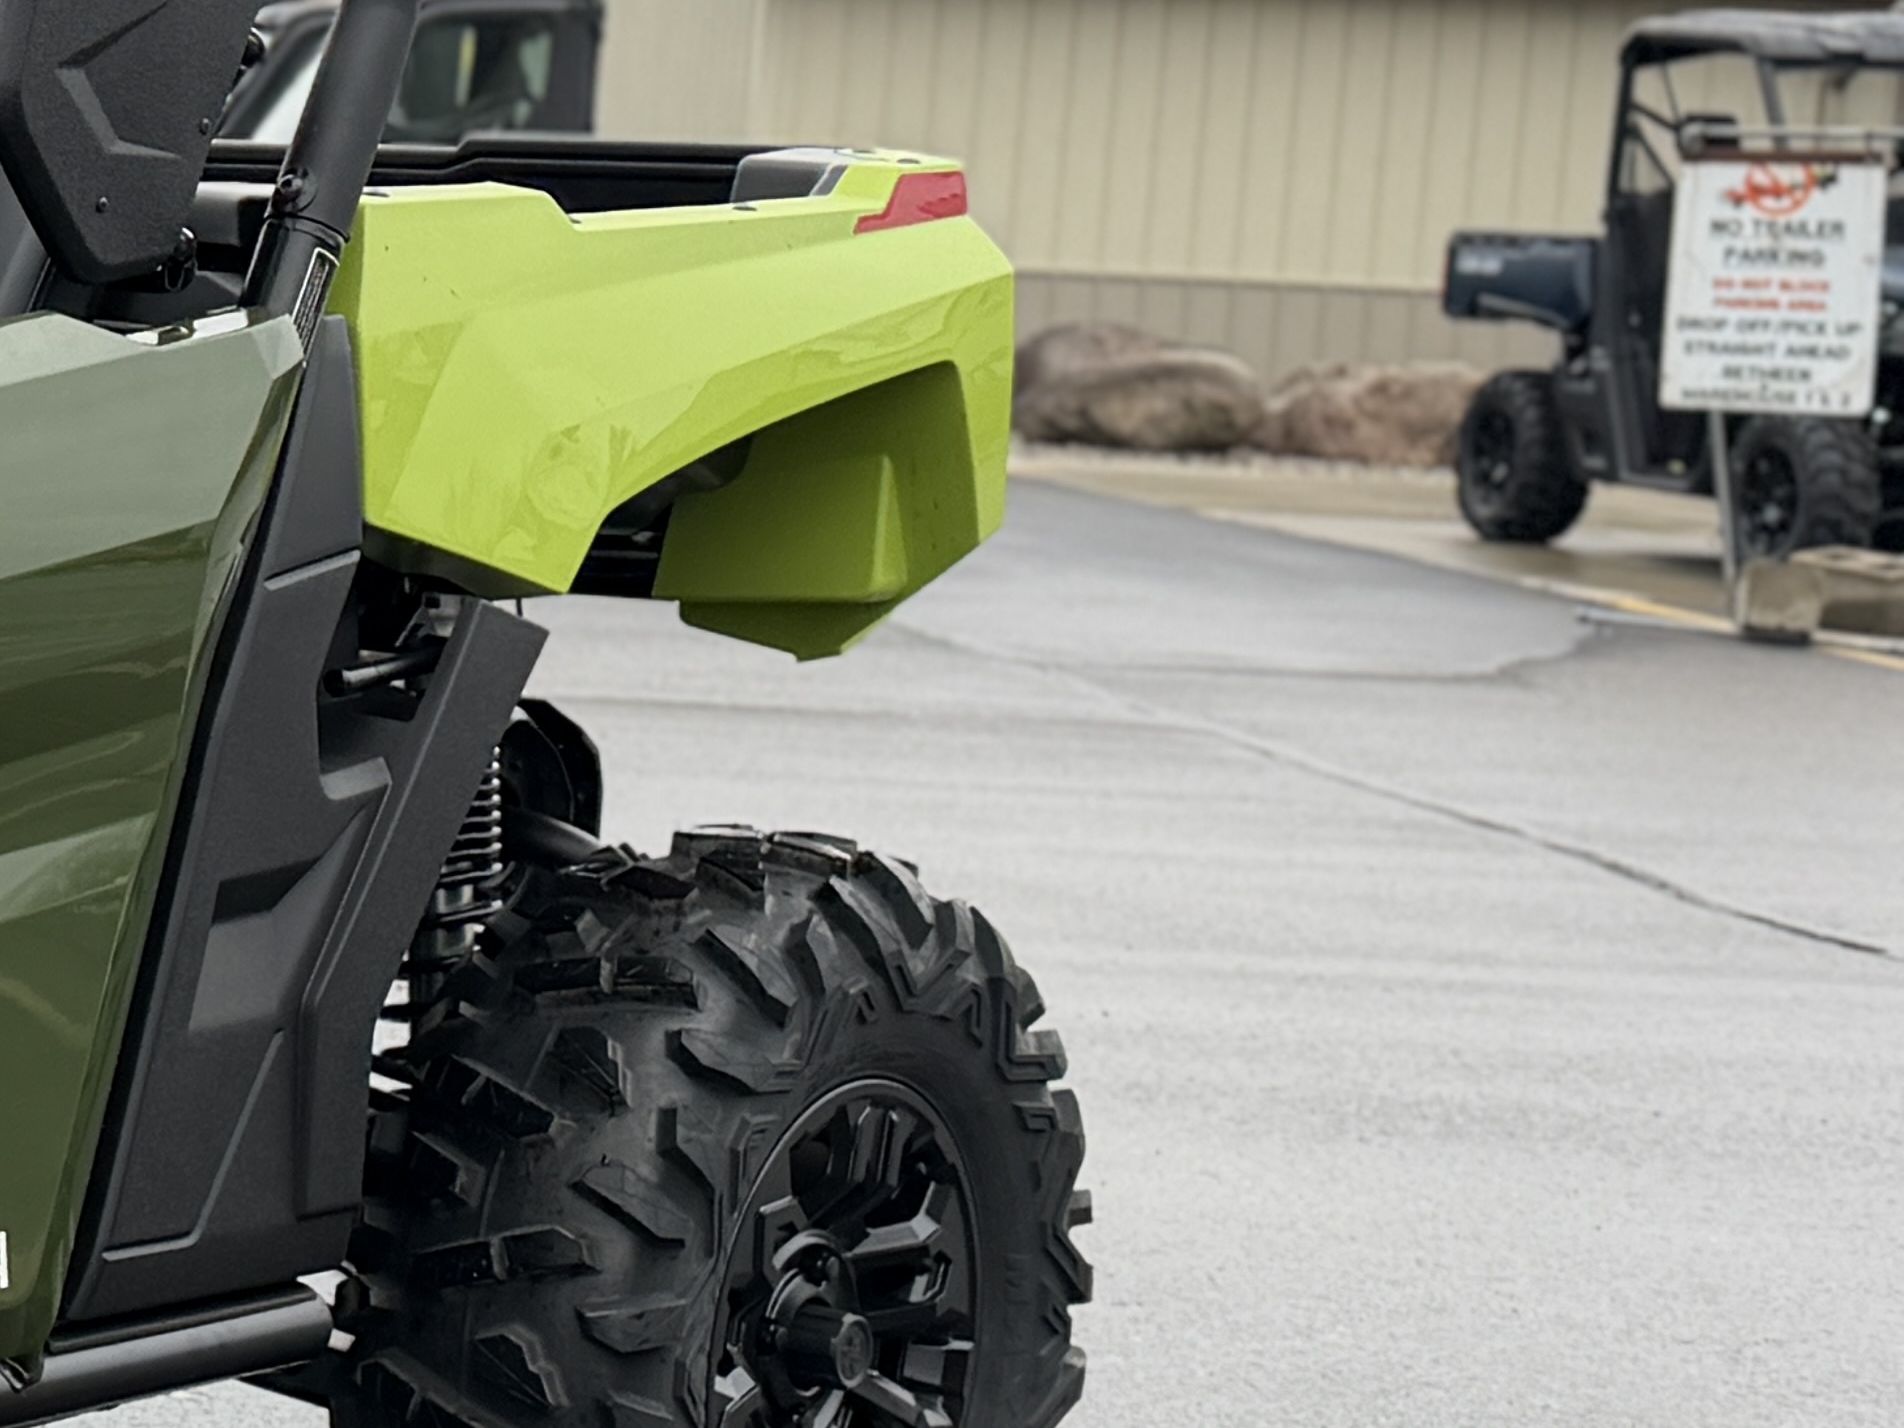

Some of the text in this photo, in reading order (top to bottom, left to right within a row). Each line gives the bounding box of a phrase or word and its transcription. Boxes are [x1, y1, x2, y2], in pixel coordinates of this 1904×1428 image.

[1710, 219, 1845, 241] NO TRAILER
[1723, 246, 1826, 268] PARKING
[1677, 316, 1728, 332] DROP
[1835, 320, 1862, 337] UP
[1684, 340, 1851, 361] STRAIGHT AHEAD
